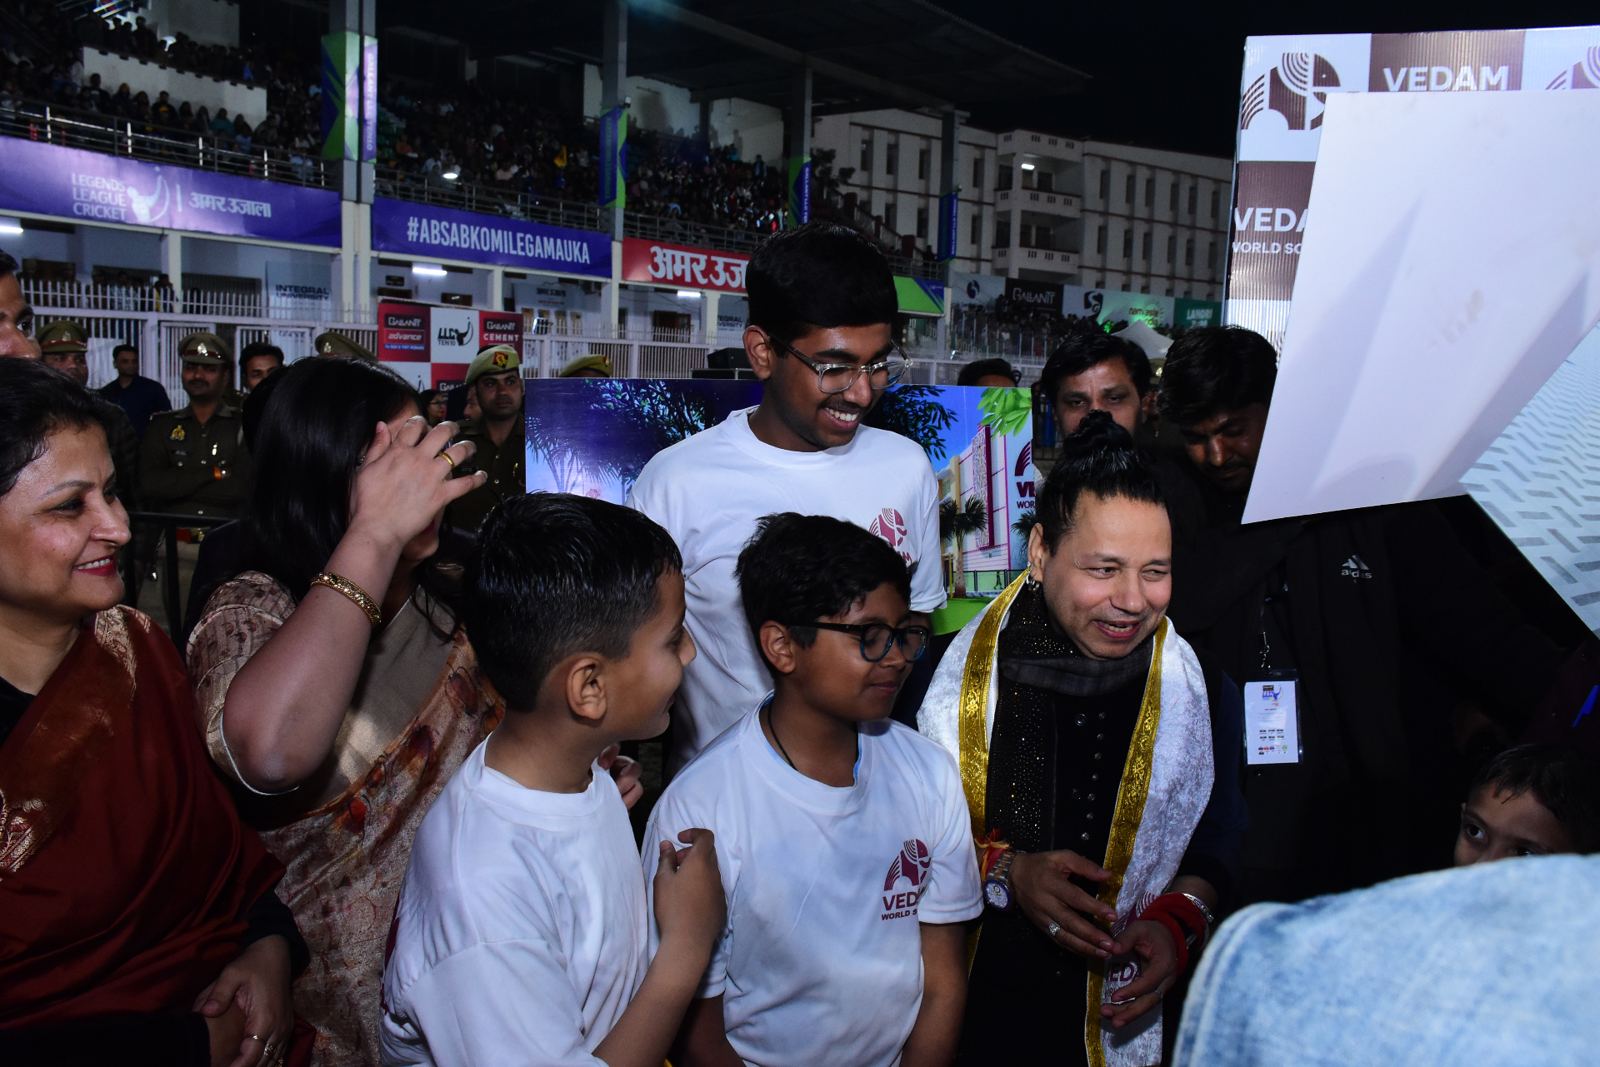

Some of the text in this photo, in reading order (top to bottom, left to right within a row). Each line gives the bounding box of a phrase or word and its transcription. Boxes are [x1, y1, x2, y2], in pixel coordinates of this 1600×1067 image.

[1383, 65, 1509, 91] VEDAM
[71, 173, 127, 193] LEGENDS
[73, 187, 127, 207] LEAGUE
[188, 191, 272, 218] अमर उजाला
[73, 202, 127, 220] CRICKET
[407, 216, 591, 264] #ABSABKOMILEGAMAUKA
[1284, 242, 1303, 254] SC
[647, 245, 748, 288] अमर उज
[482, 332, 520, 342] CEMENT
[882, 889, 921, 911] VED
[881, 910, 910, 921] WORLD
